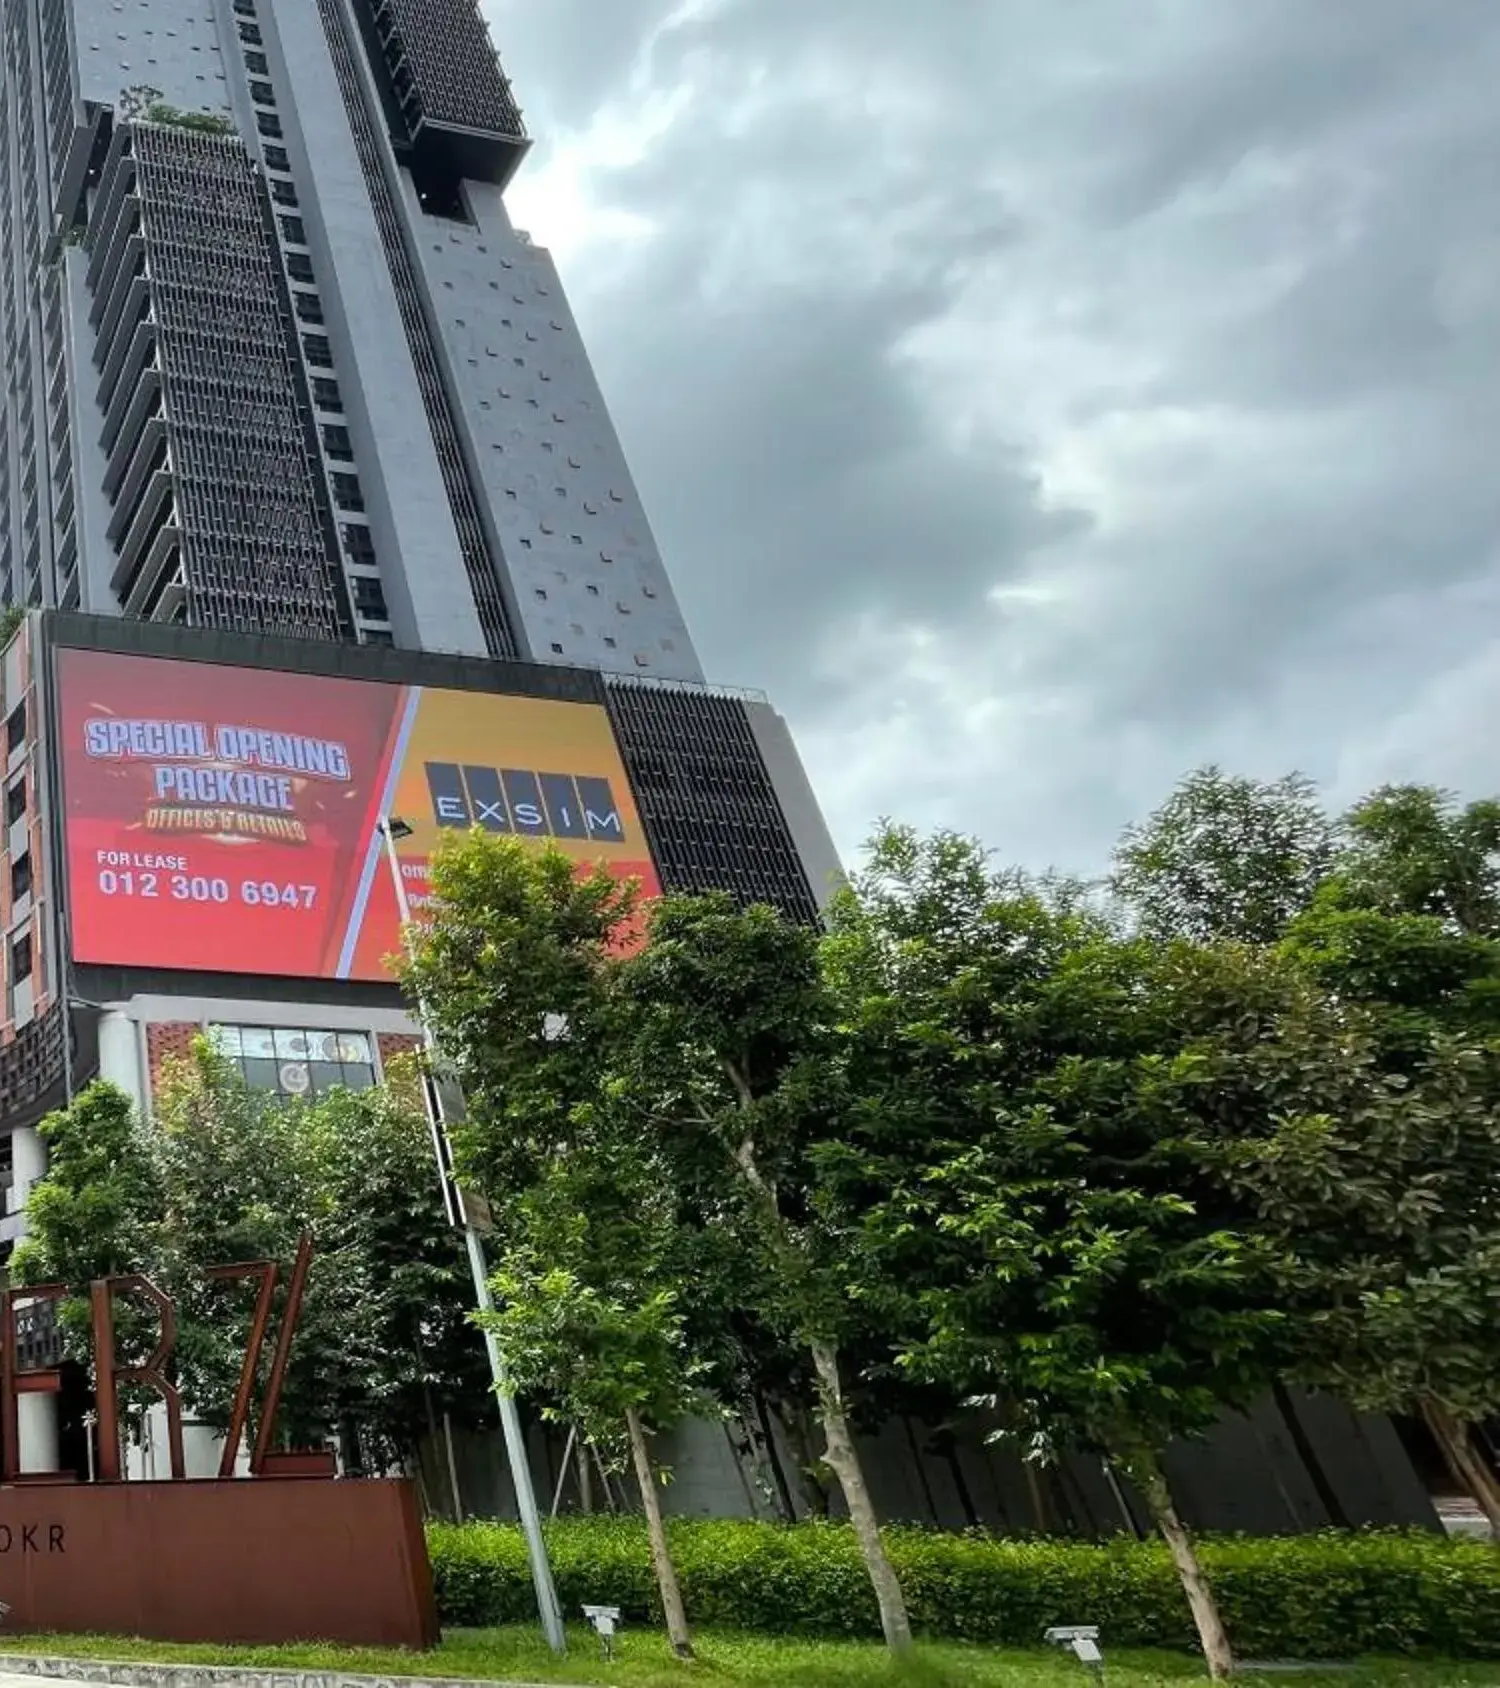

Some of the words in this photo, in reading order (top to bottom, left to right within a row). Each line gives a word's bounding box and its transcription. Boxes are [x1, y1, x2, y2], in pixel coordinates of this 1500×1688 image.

[86, 719, 213, 761] SPECIAL
[214, 724, 351, 781] OPENING
[154, 765, 295, 811] PACKAGE
[146, 807, 217, 829] OFFICES
[435, 796, 622, 833] EXSIM
[97, 850, 131, 867] FOR
[134, 853, 189, 871] LEASE
[99, 869, 159, 897] 012
[171, 875, 230, 902] 300
[241, 880, 317, 909] 6947
